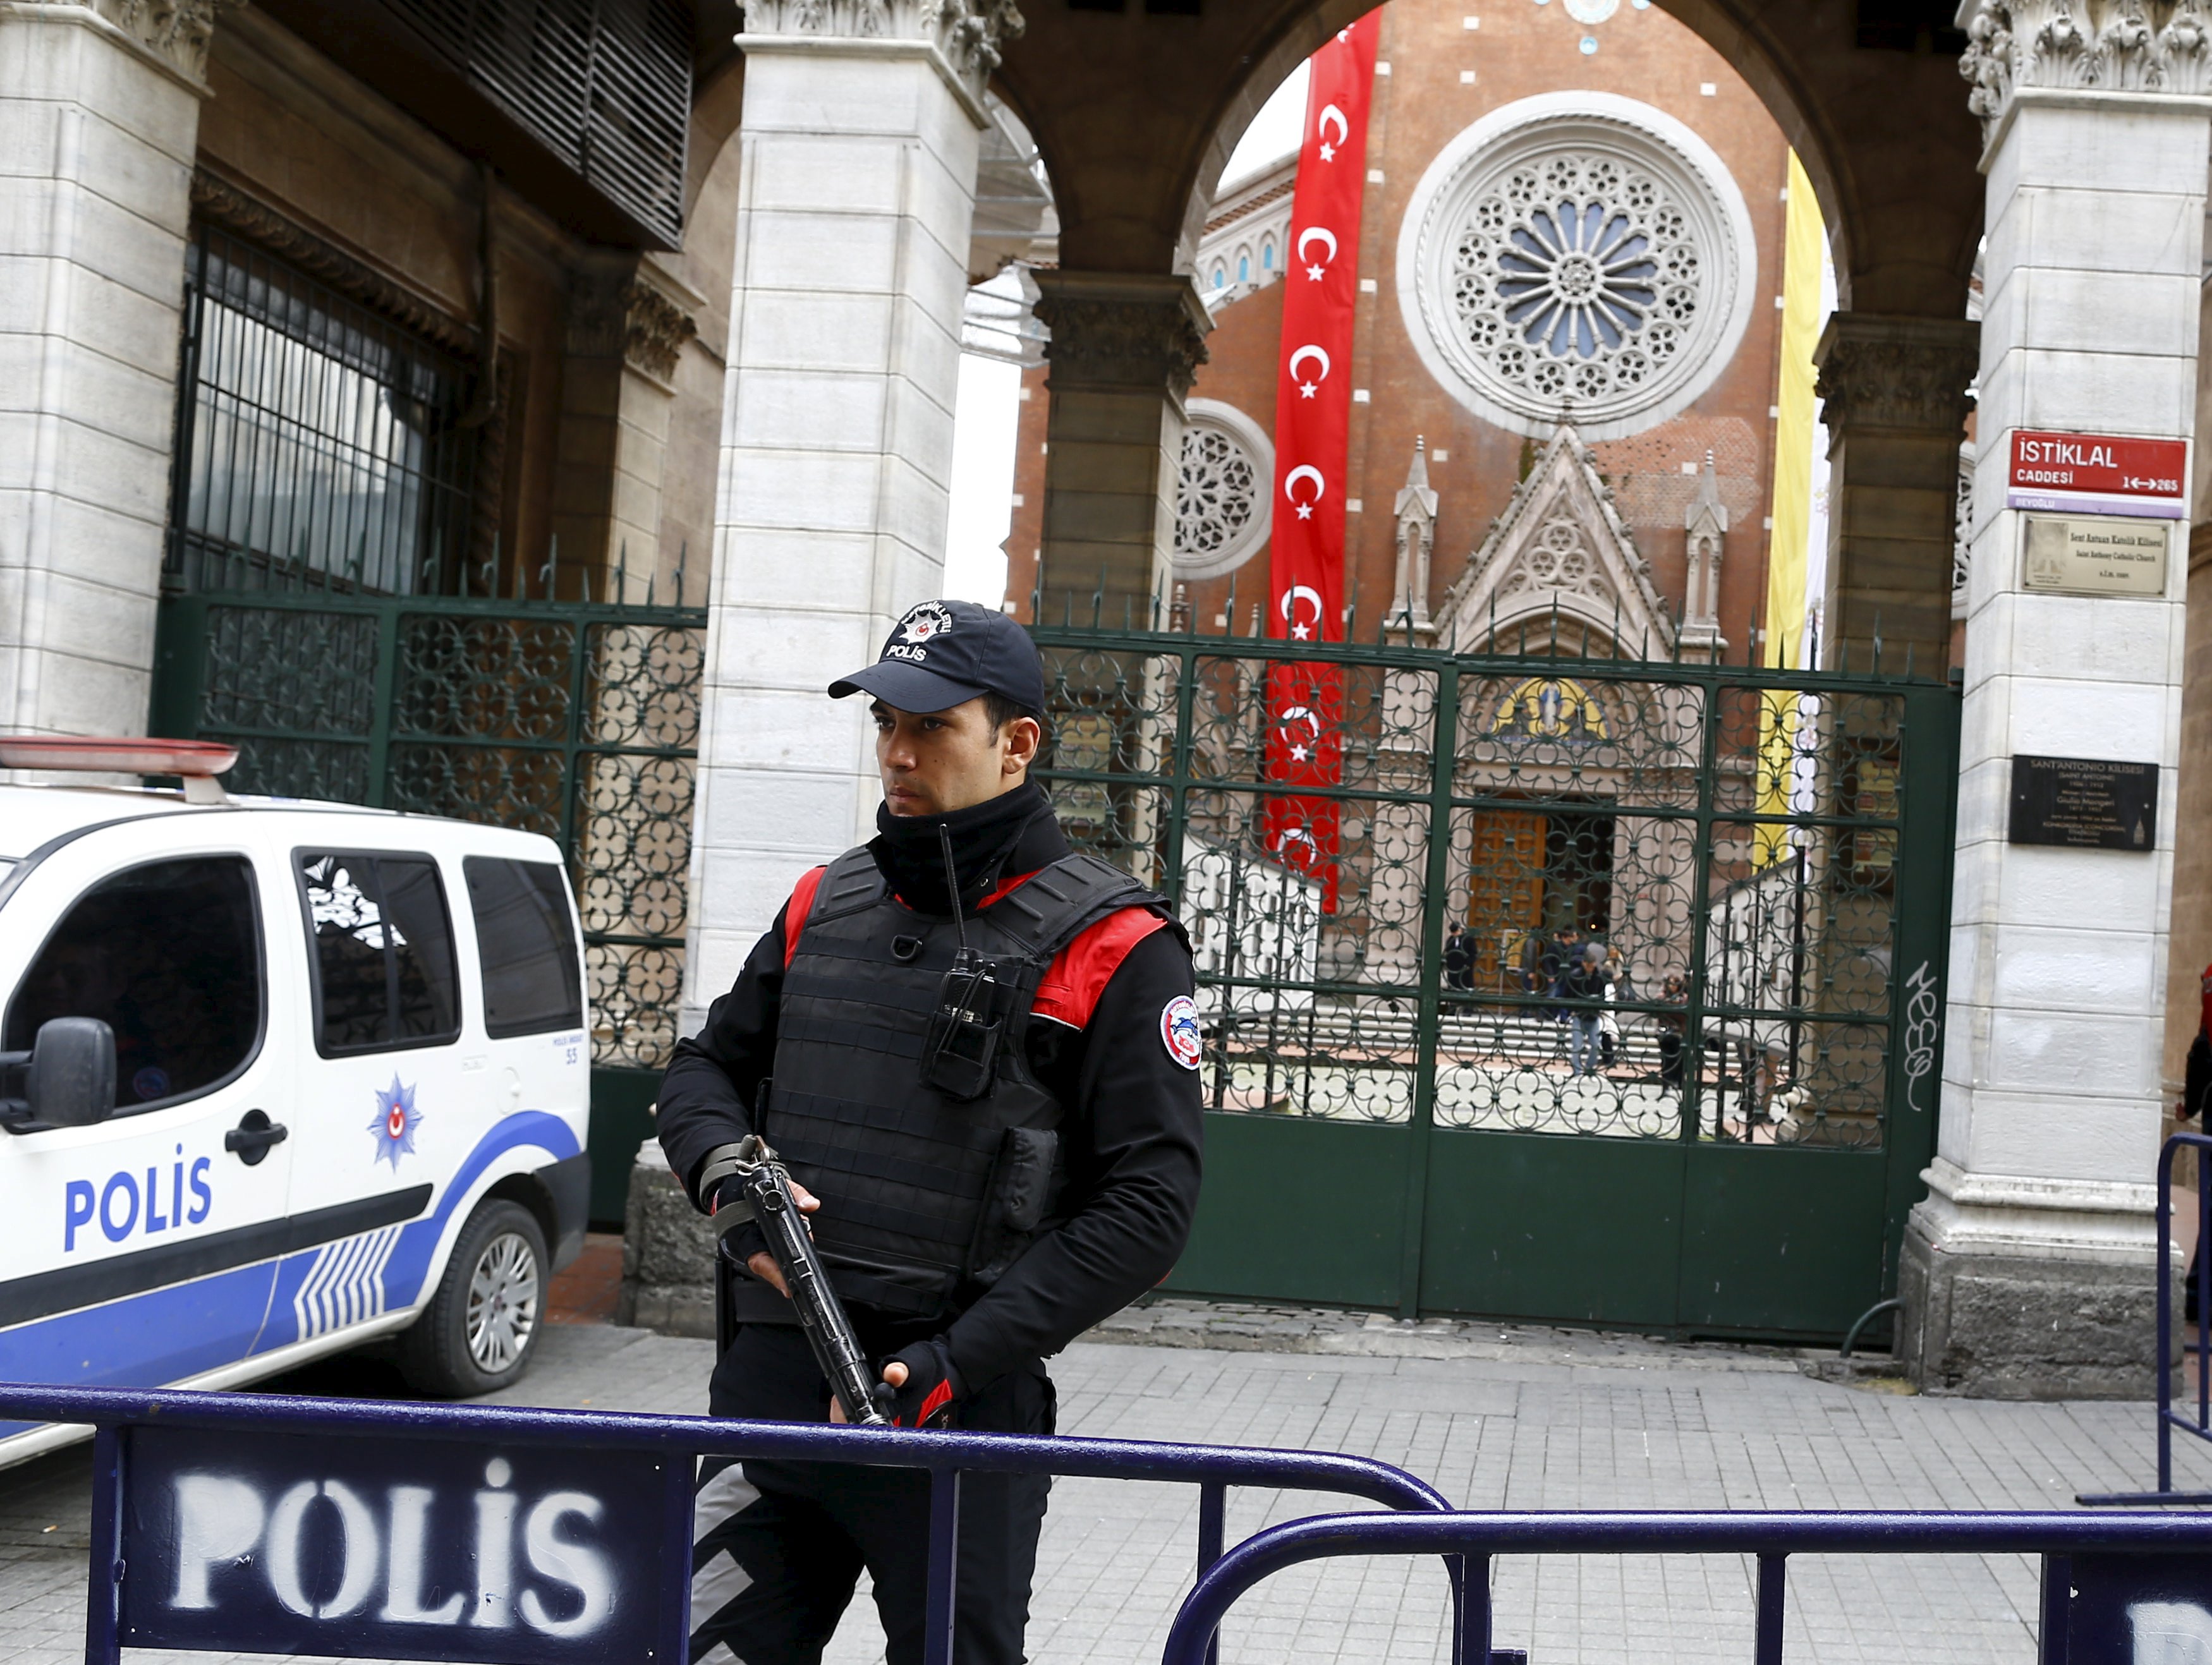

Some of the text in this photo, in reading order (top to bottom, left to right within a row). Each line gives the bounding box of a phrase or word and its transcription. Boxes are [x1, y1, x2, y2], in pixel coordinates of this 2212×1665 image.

[2019, 437, 2118, 468] İSTİKLAL
[2017, 469, 2074, 485] CADDESİ
[886, 645, 927, 662] POLİS
[64, 1142, 212, 1253] POLİS
[168, 1457, 617, 1638] POLİS
